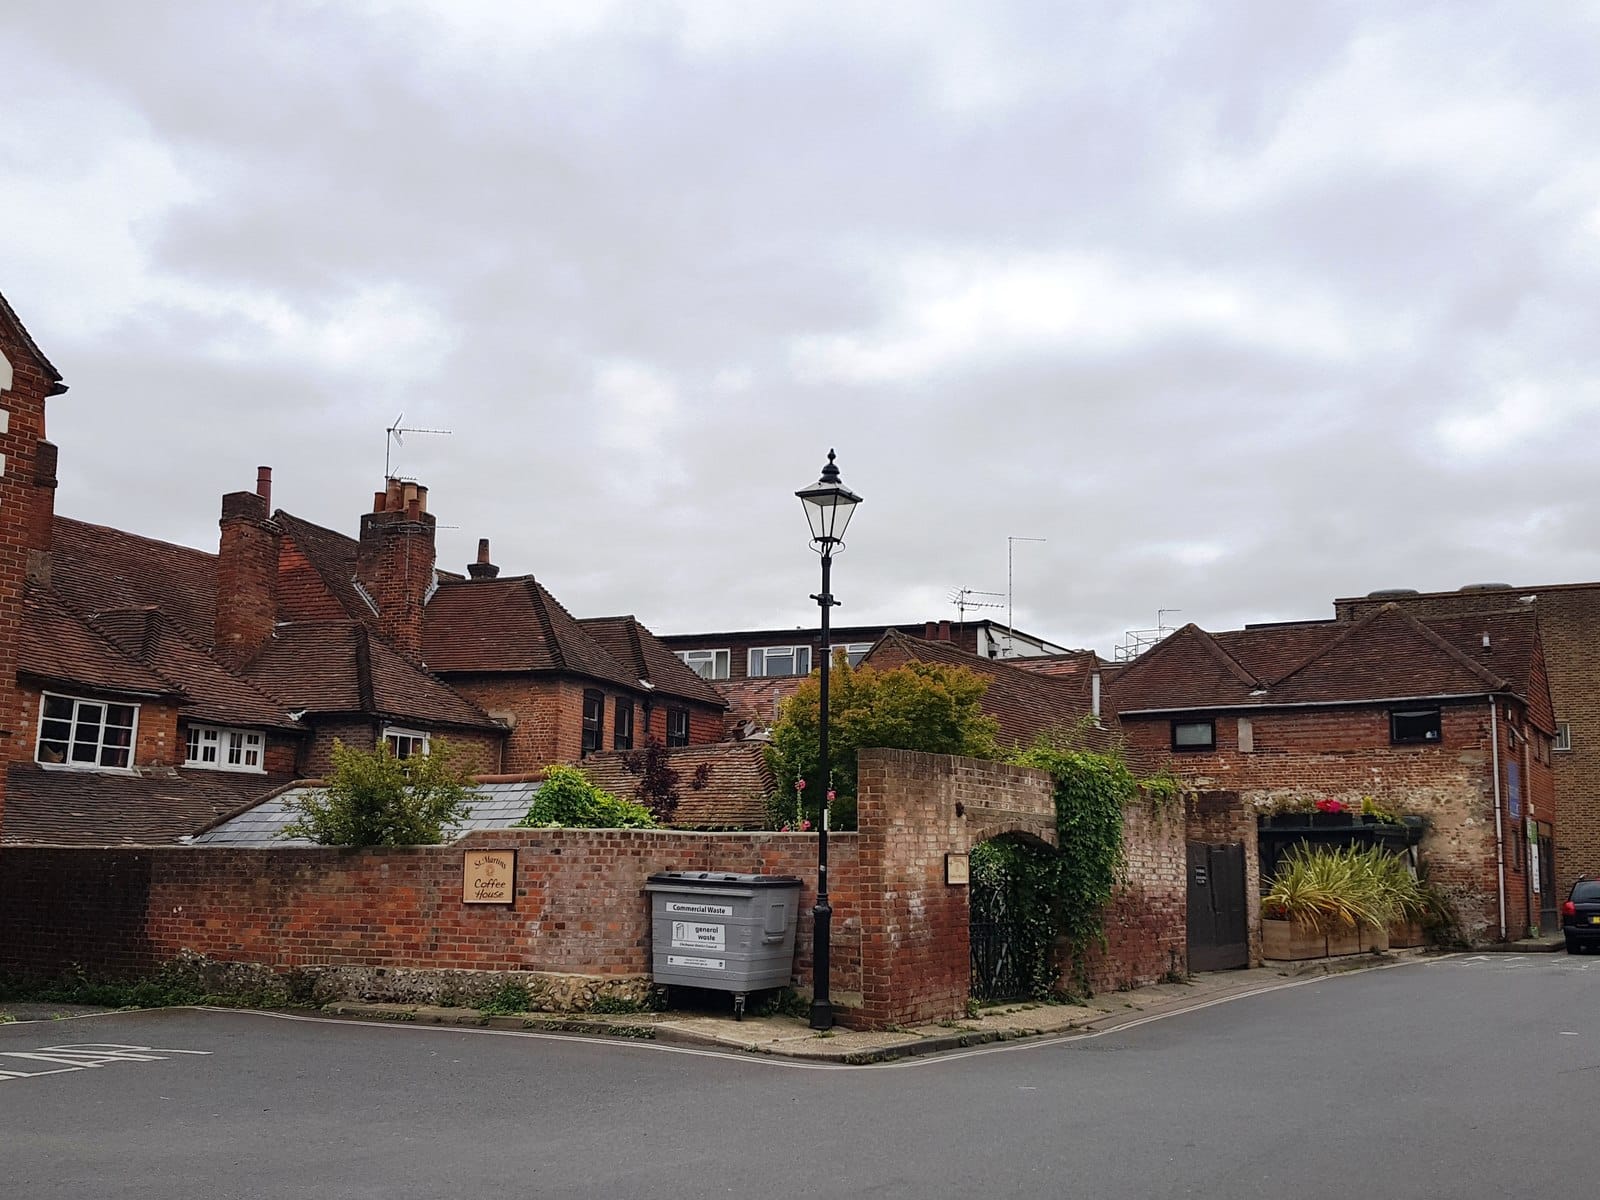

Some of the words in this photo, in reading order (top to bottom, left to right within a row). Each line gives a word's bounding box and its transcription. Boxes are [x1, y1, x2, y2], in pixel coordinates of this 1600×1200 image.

[474, 878, 506, 889] Coffee
[474, 888, 505, 900] House
[673, 904, 707, 914] Commercial
[707, 906, 726, 915] Waste
[695, 926, 719, 934] general
